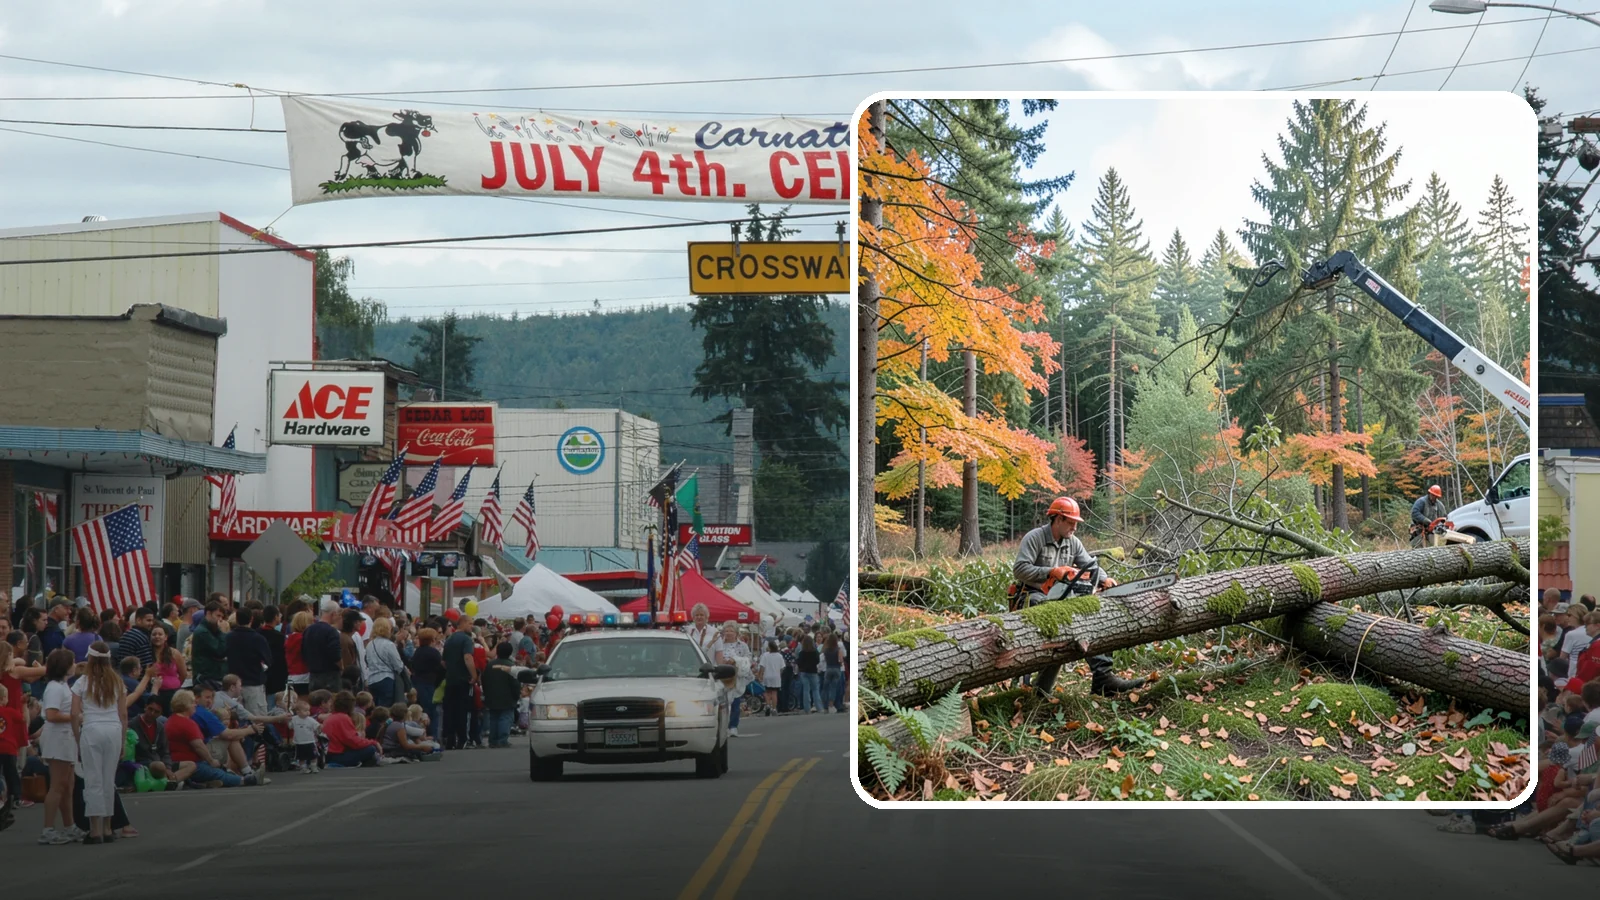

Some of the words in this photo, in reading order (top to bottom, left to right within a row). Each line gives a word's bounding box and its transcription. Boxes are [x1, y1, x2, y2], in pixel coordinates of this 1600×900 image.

[481, 141, 604, 193] JULY
[633, 151, 746, 198] 4th.
[697, 254, 850, 280] CROSSWA
[282, 380, 373, 419] ACE
[405, 408, 452, 422] CEDAR
[461, 409, 485, 421] LOG
[283, 420, 371, 436] Hardware
[353, 467, 385, 480] Simpl
[83, 485, 93, 494] St.
[95, 485, 124, 495] Vincent
[126, 486, 135, 495] de
[137, 486, 155, 495] Paul
[688, 526, 741, 535] CRNATION
[699, 535, 730, 543] GLASS
